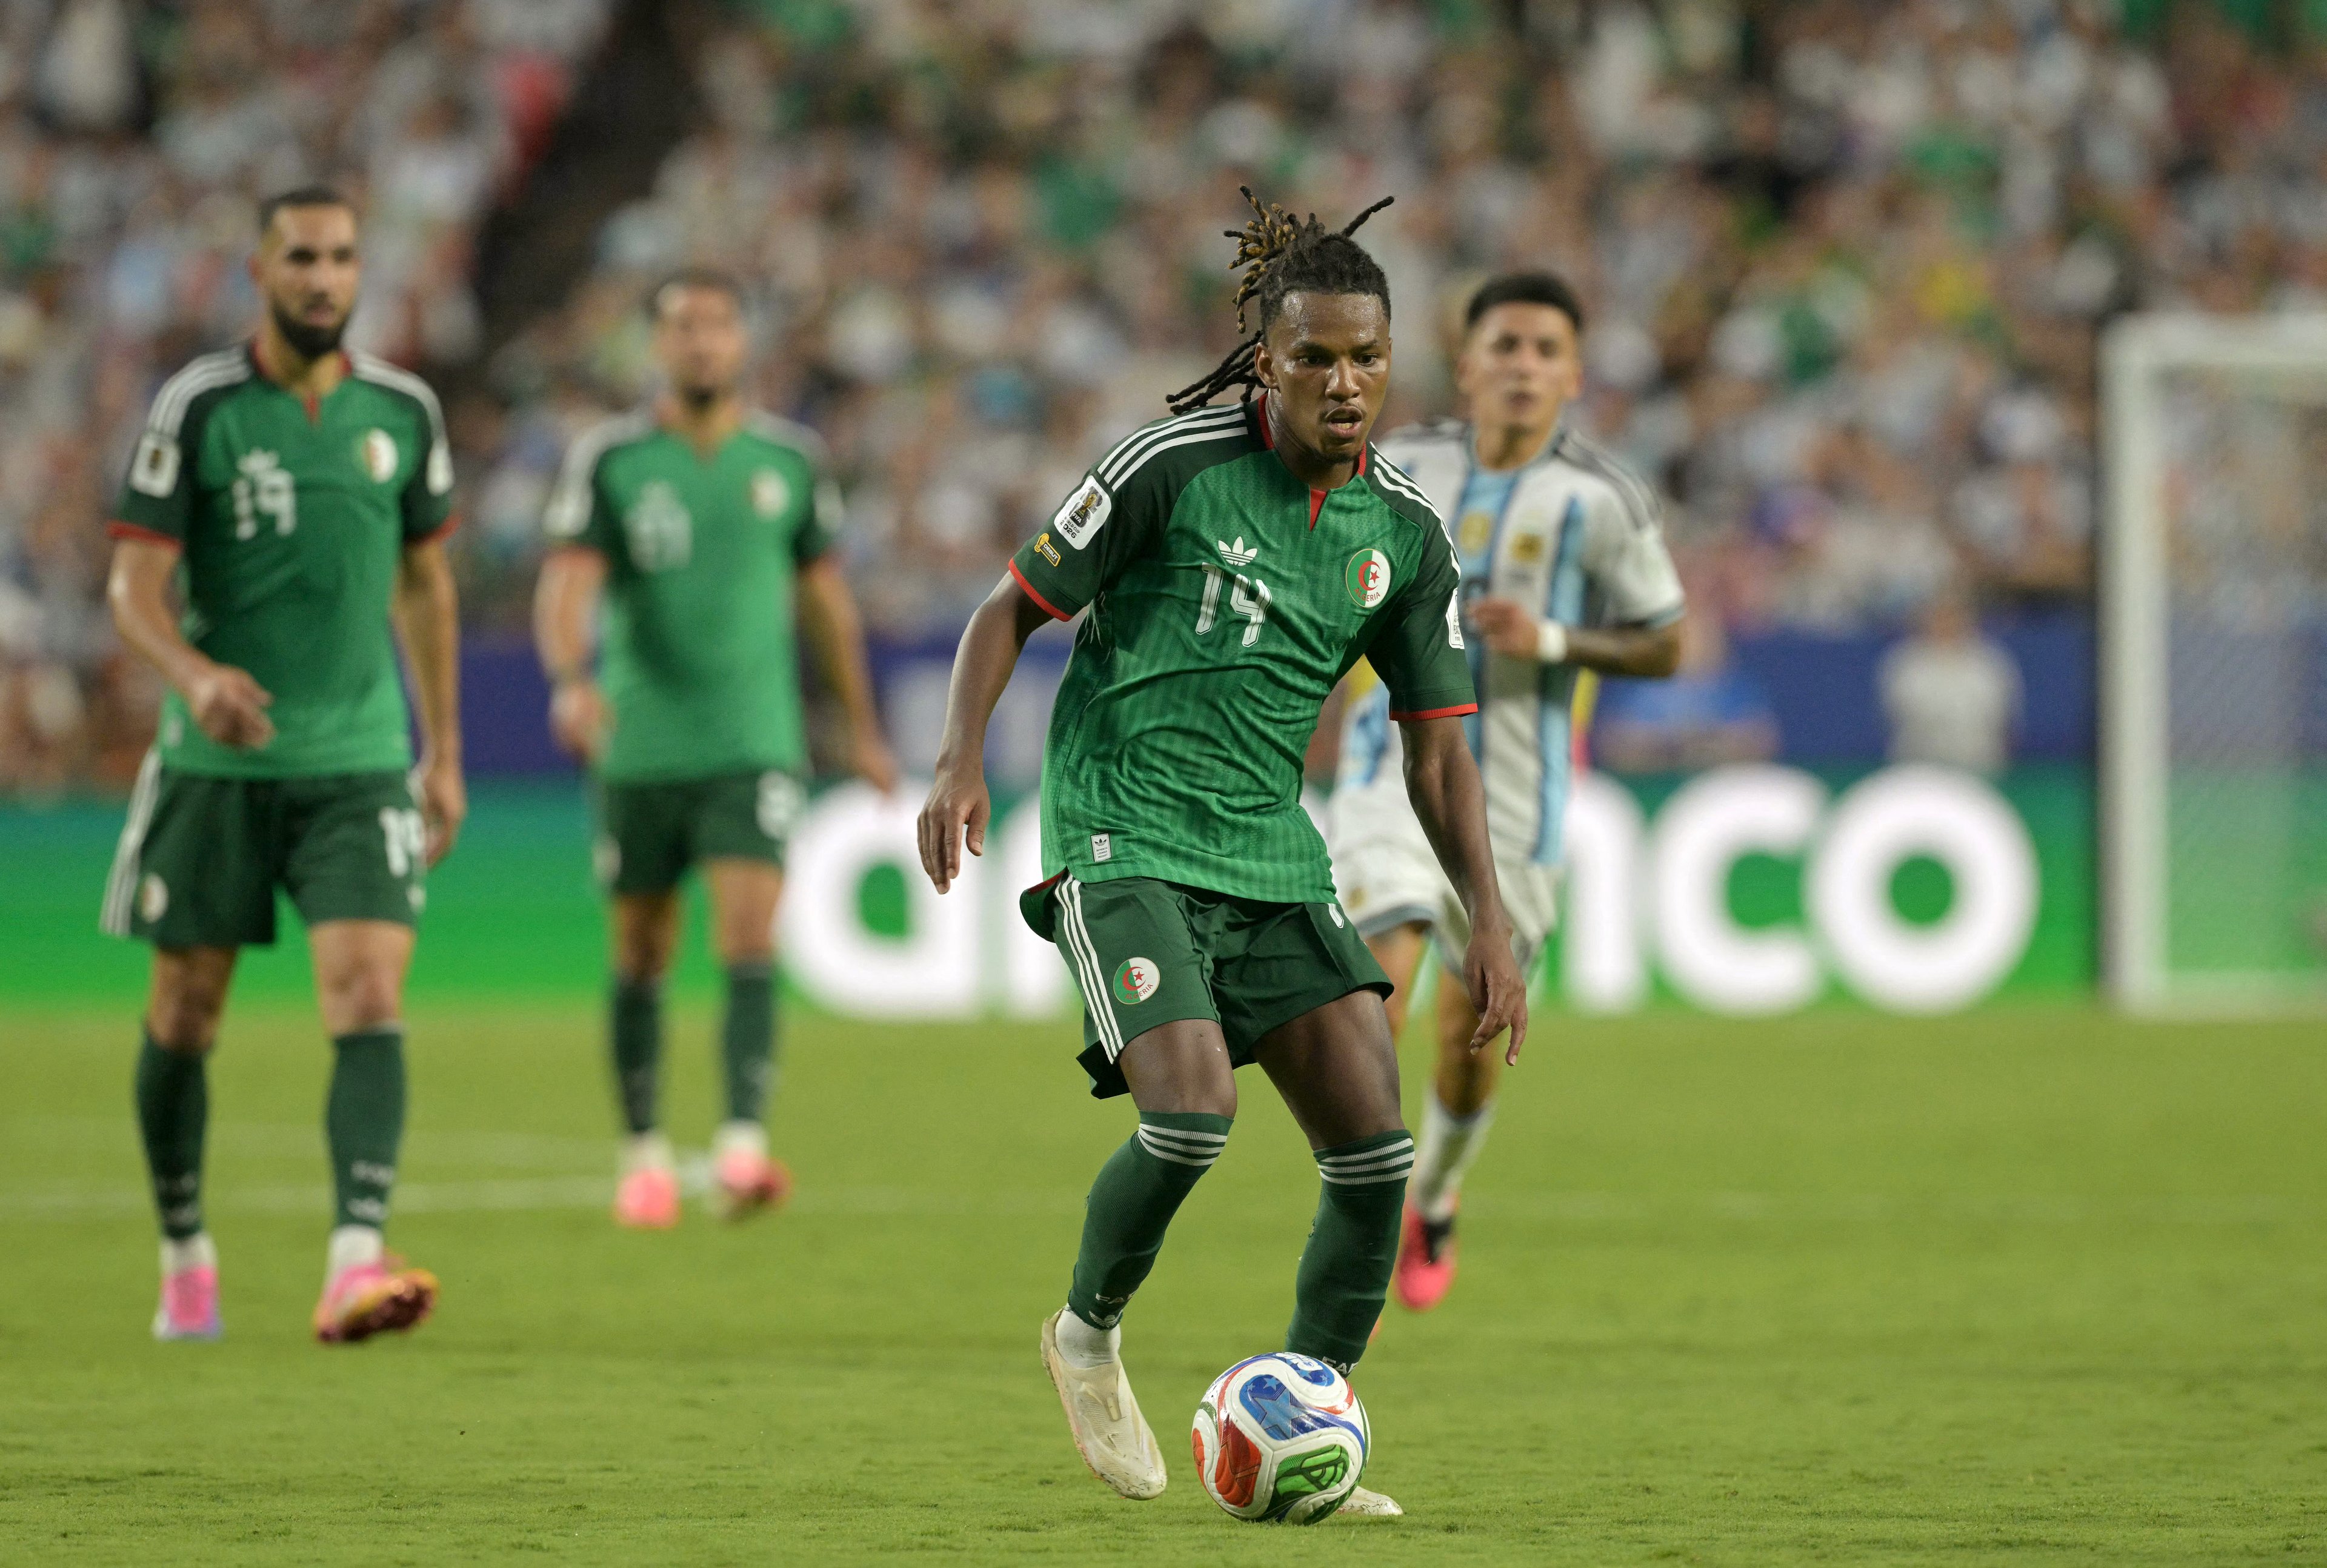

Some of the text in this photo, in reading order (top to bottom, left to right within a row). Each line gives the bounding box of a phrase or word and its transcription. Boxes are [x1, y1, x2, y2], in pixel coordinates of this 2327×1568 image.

[1072, 513, 1082, 523] FIFA
[1044, 543, 1058, 559] DEBUT
[1354, 587, 1380, 602] ALGERIA
[1195, 562, 1272, 647] 14
[1125, 983, 1153, 1000] ALGERIA
